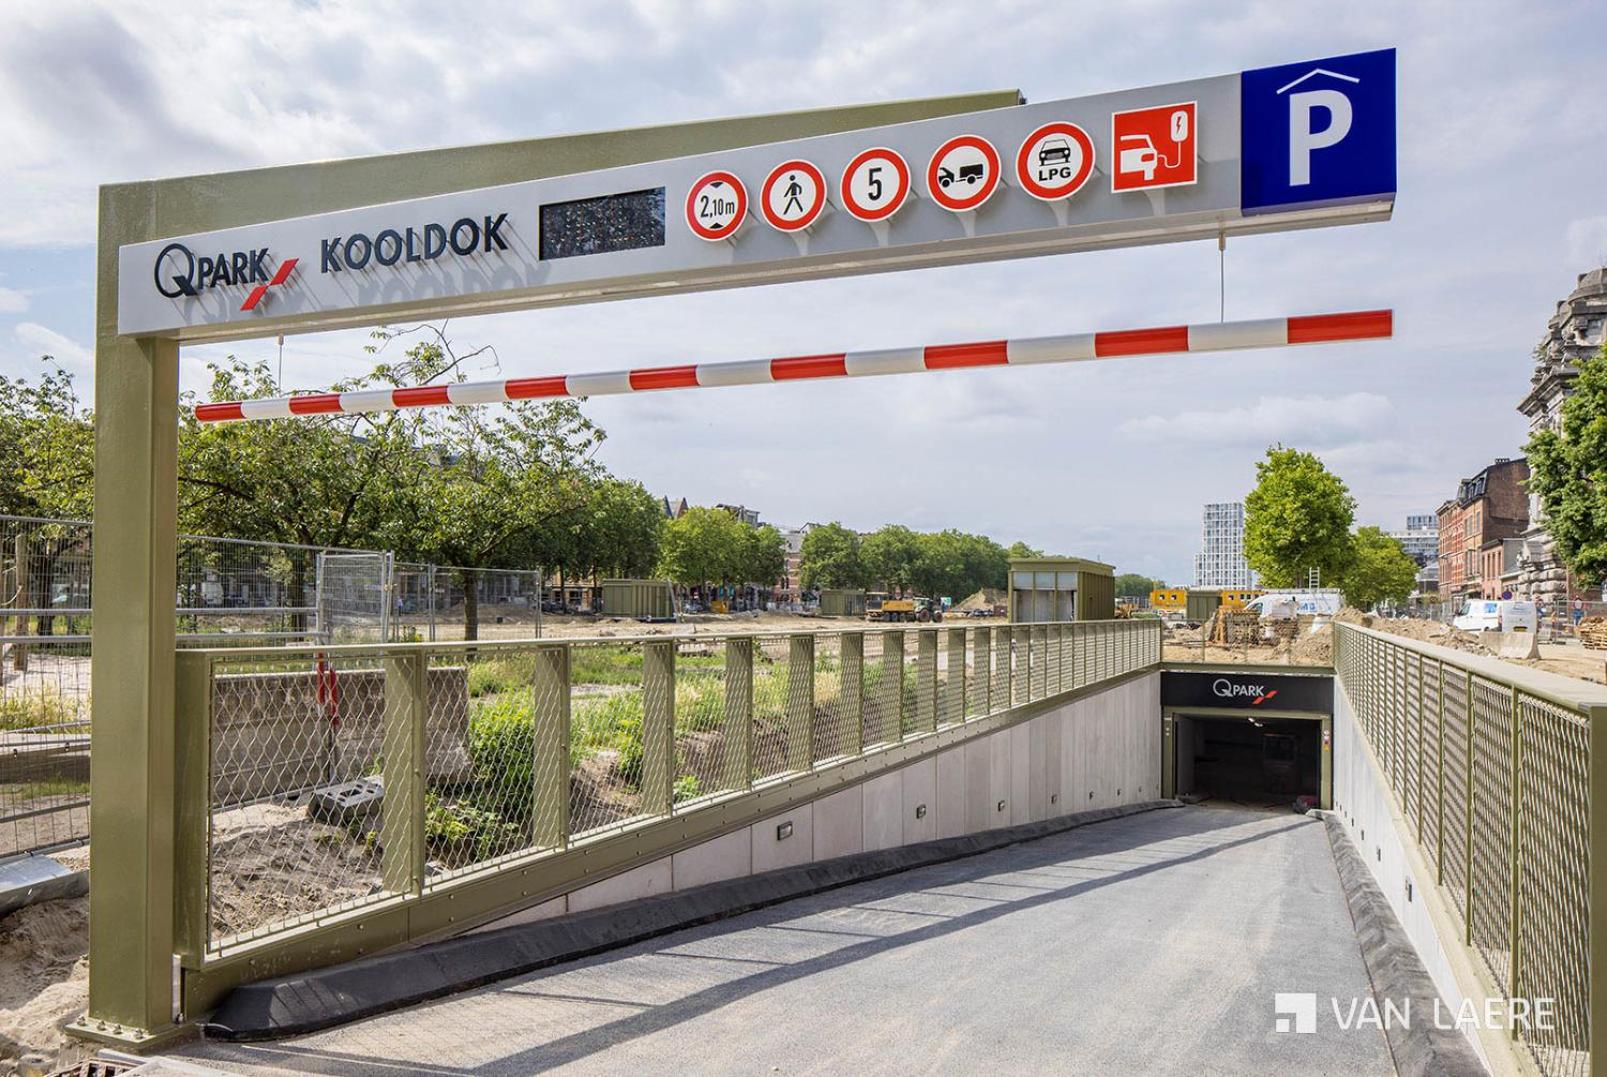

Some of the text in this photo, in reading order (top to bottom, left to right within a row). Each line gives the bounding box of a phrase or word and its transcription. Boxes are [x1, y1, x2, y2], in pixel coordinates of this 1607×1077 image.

[1289, 89, 1353, 187] P
[867, 166, 883, 201] 5
[1038, 166, 1072, 182] LPG
[320, 212, 509, 274] KOOLDOK
